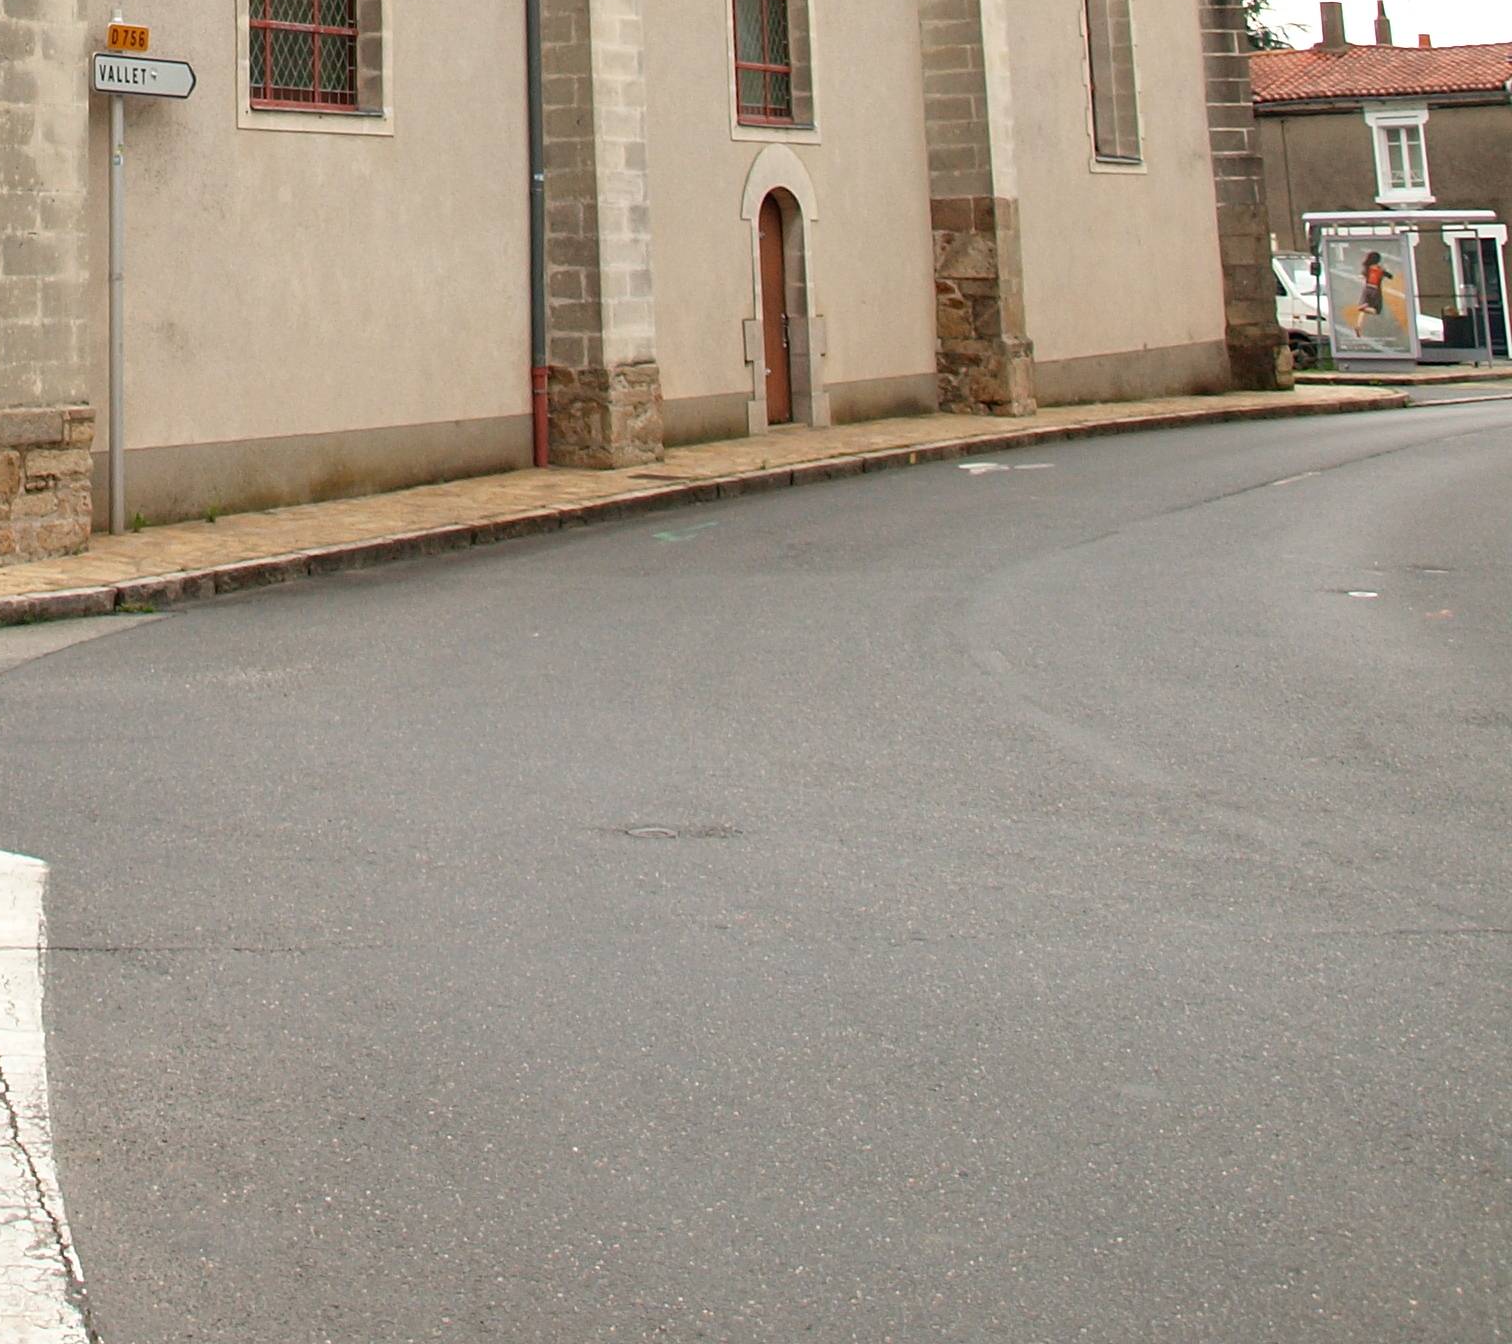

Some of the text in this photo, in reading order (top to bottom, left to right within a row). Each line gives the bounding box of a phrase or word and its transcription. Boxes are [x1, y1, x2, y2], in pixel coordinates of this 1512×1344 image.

[111, 28, 145, 48] D 756
[99, 64, 146, 85] VALLET
